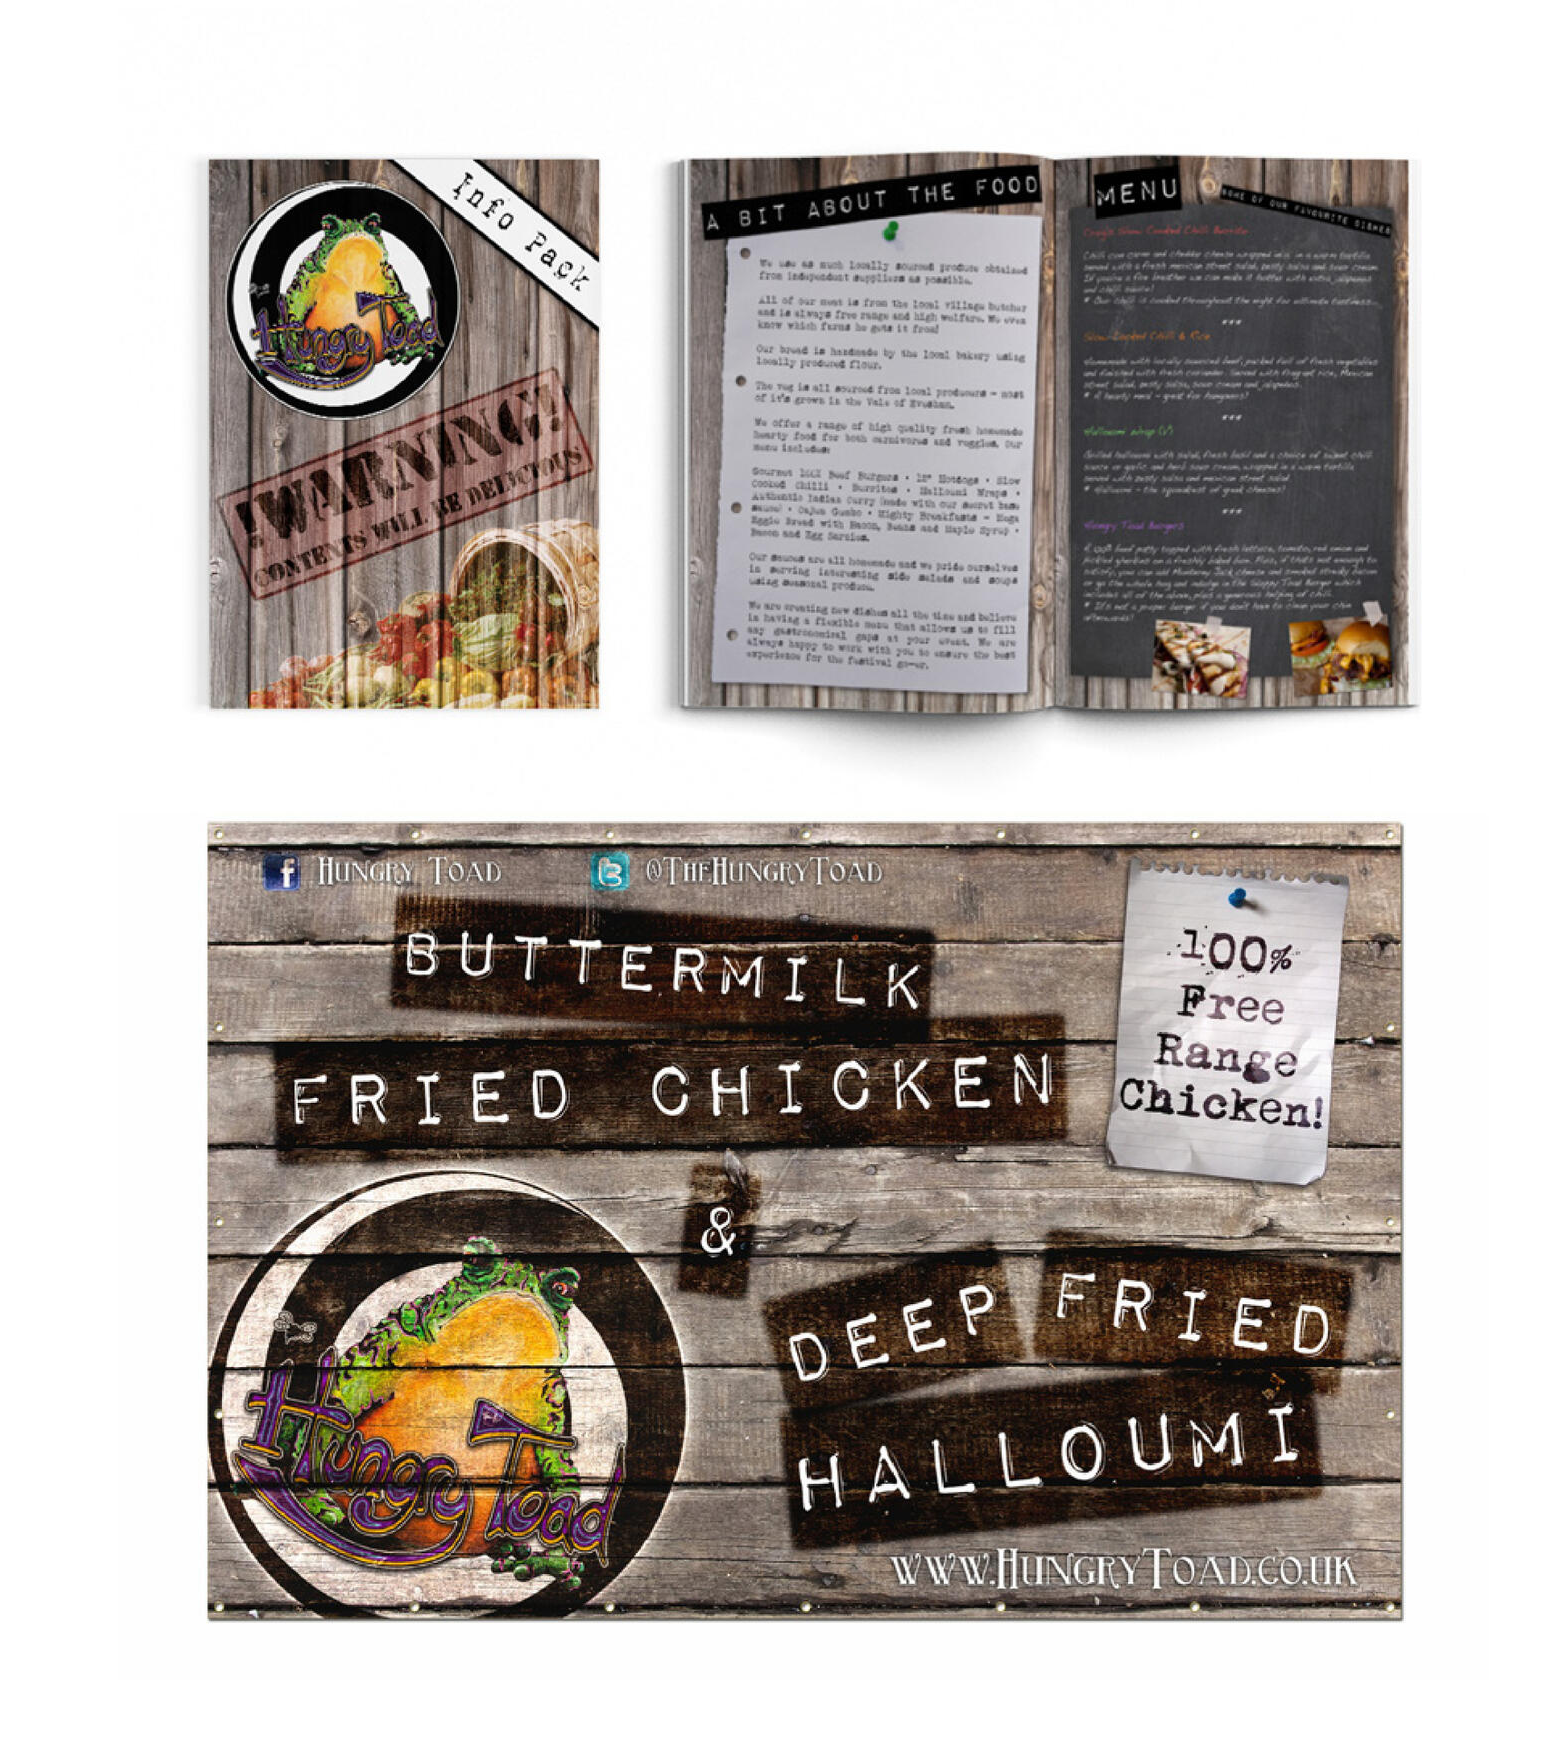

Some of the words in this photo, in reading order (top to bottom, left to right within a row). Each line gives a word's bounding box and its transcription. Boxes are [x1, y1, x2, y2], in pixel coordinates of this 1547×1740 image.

[706, 214, 719, 231] A
[740, 204, 786, 227] BIT
[808, 190, 887, 218] ABOUT
[908, 182, 955, 204] THE
[976, 175, 1038, 196] FOOD
[1095, 178, 1177, 207] MENU
[451, 172, 514, 231] Info
[525, 231, 591, 292] Pack
[254, 530, 367, 588] CONTENTS
[371, 508, 428, 542] WILL
[431, 492, 463, 521] BE
[467, 447, 584, 505] DELICIOUS
[404, 930, 922, 1010] BUTTERMILK
[1180, 927, 1294, 975] 100%
[1177, 984, 1285, 1025] Free
[1154, 1031, 1298, 1083] Range
[293, 1068, 571, 1126] FRIED
[651, 1053, 1053, 1118] CHICKEN
[1120, 1077, 1324, 1130] Chicken!
[701, 1206, 736, 1257] &
[788, 1283, 997, 1384] DEEP
[1055, 1272, 1333, 1356] FRIED
[797, 1402, 1301, 1512] HALLOUMI
